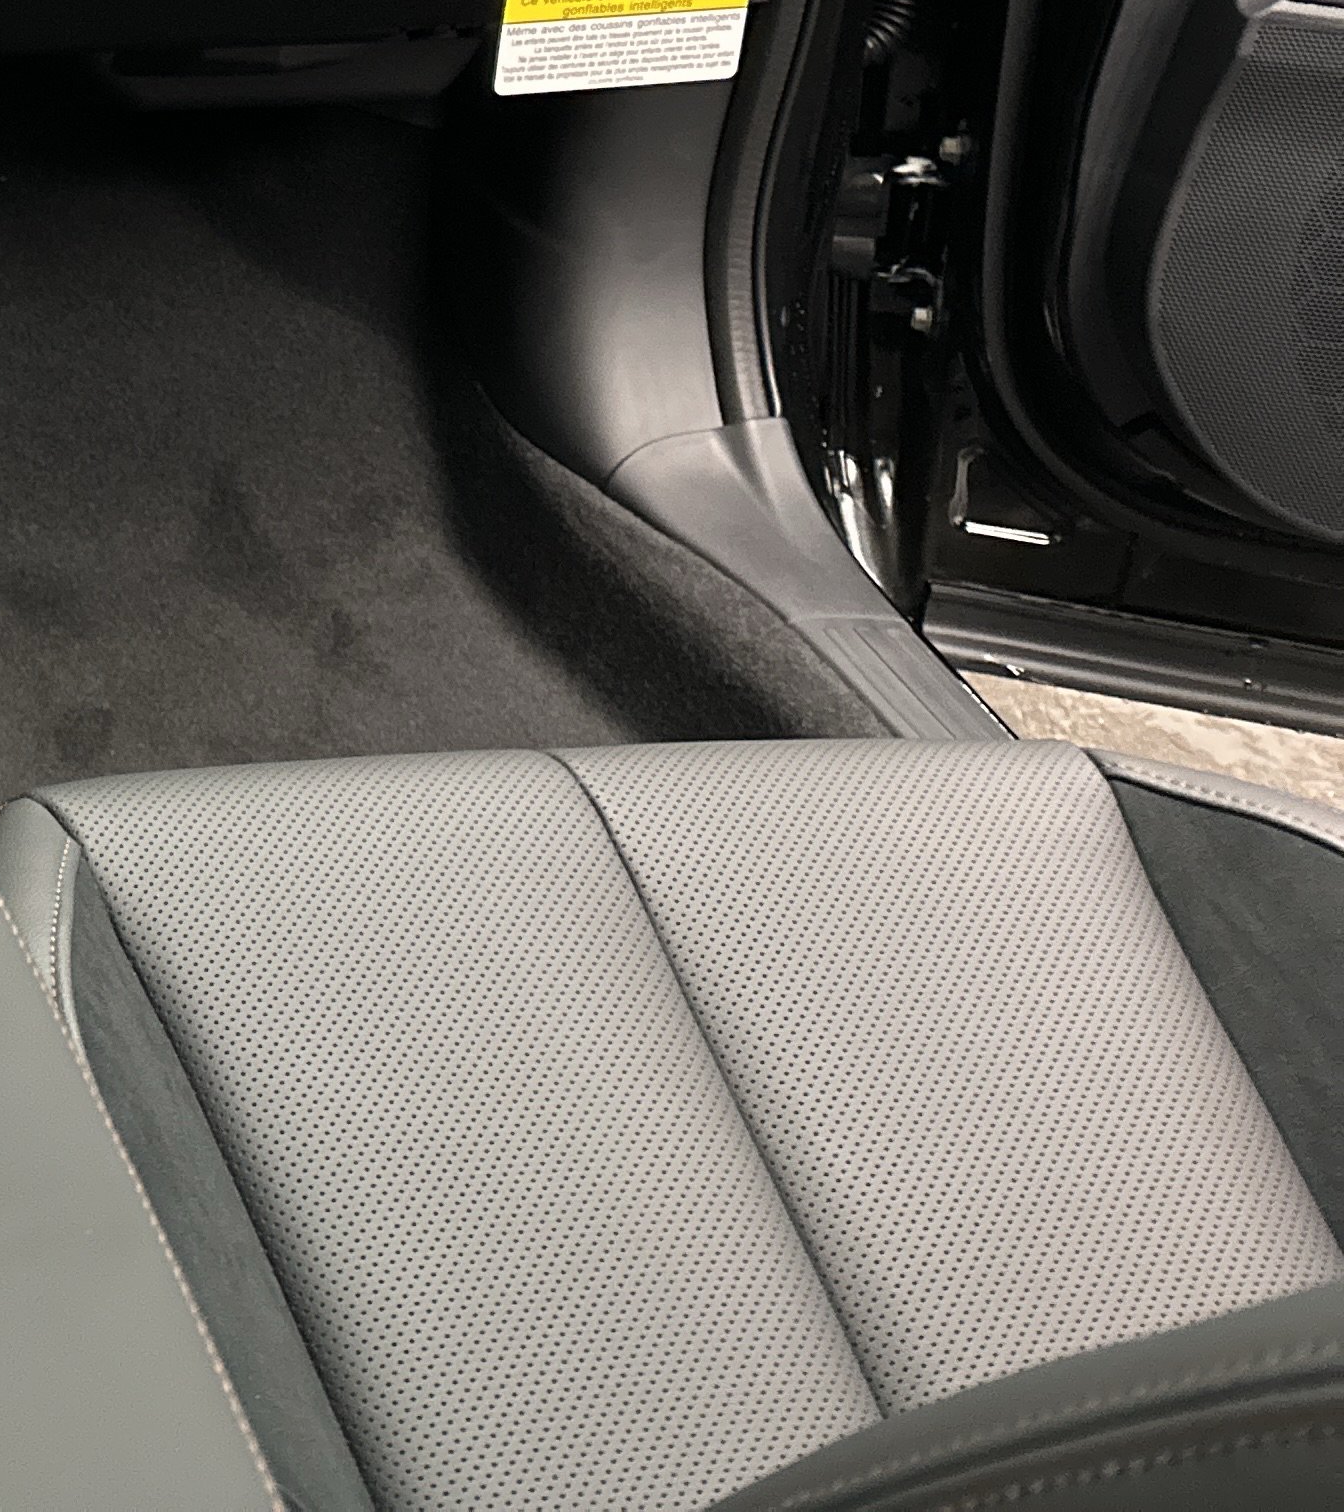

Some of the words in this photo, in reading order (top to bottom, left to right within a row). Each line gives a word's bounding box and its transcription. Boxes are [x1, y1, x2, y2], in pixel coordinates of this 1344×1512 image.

[562, 3, 624, 18] gonflables
[541, 26, 565, 34] avec
[569, 24, 586, 32] des
[590, 21, 633, 30] coussins
[690, 13, 740, 25] intelligents
